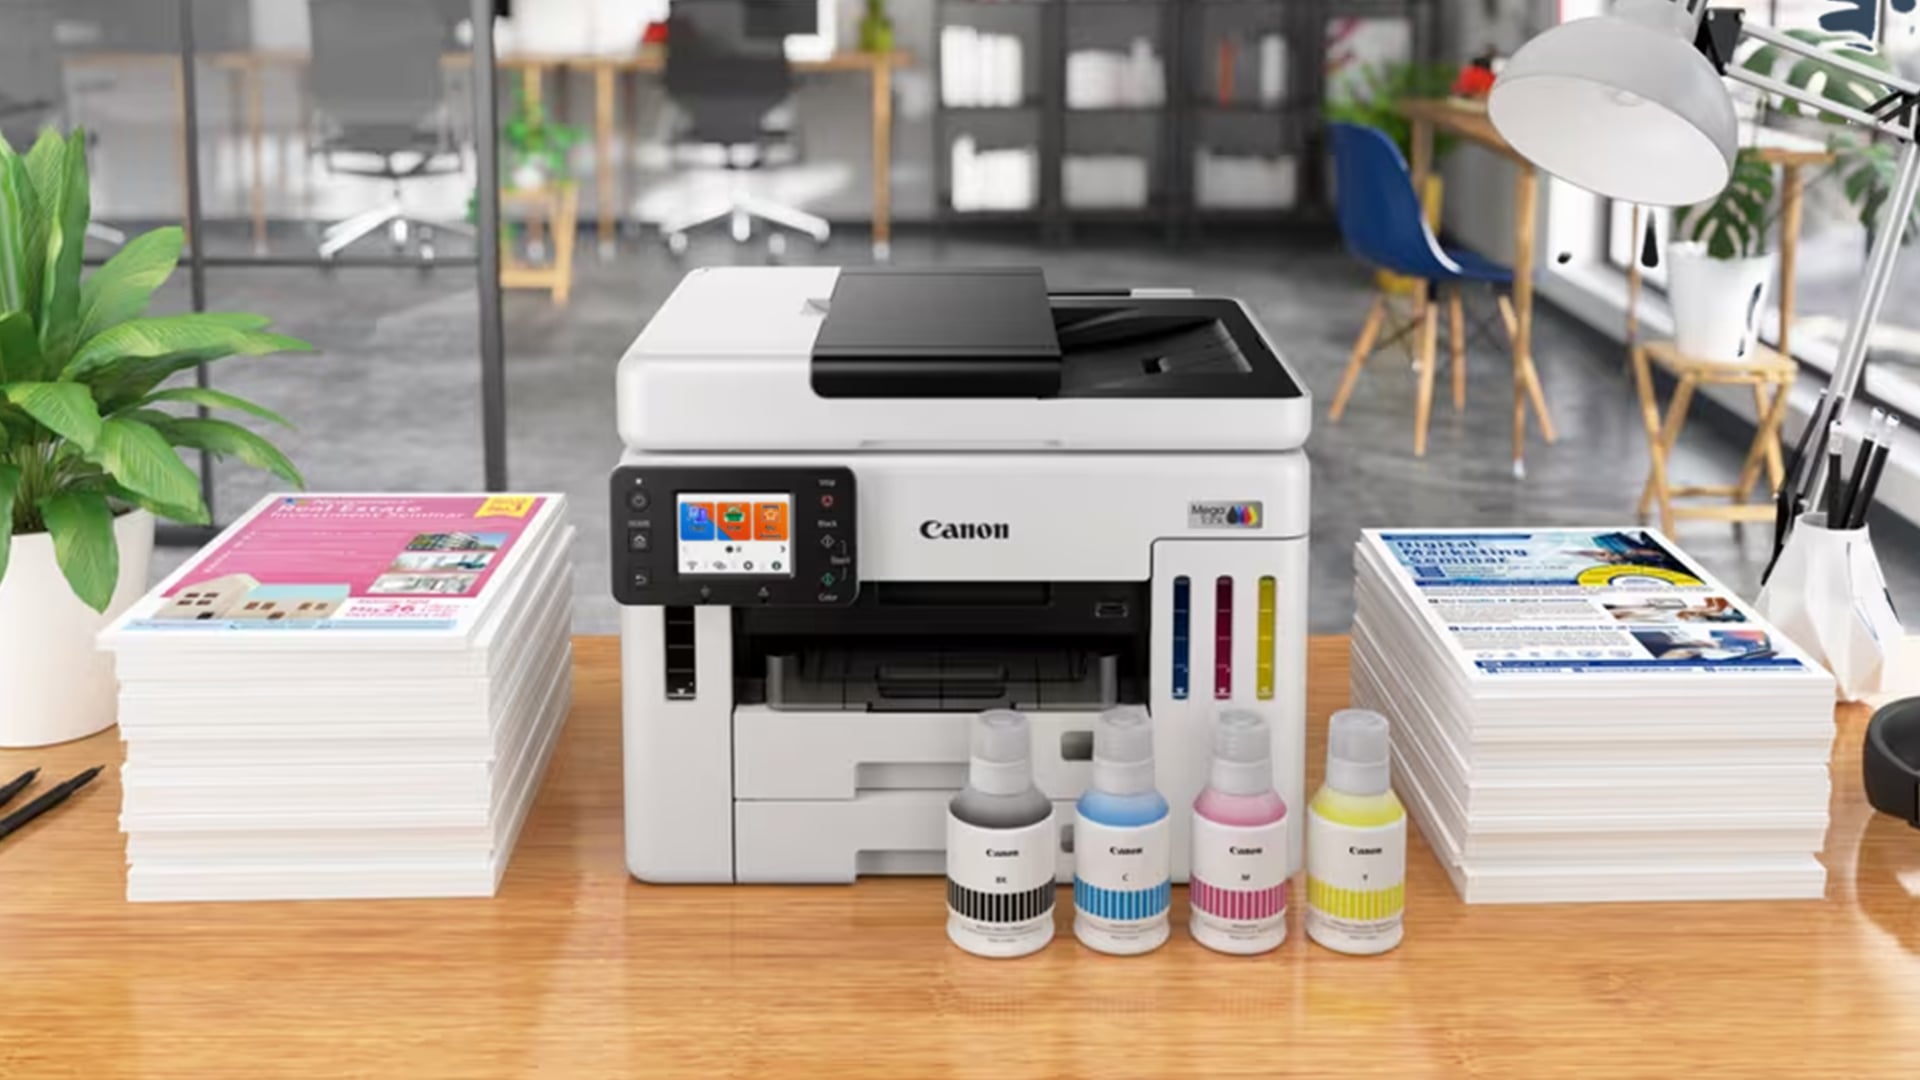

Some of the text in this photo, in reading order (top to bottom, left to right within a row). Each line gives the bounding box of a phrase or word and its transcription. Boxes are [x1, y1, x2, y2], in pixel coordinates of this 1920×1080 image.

[340, 504, 423, 512] Estate
[919, 520, 1010, 540] Canon
[1397, 539, 1478, 549] Digital
[1402, 547, 1529, 557] Marketing
[1408, 556, 1506, 564] Seminar
[986, 849, 1019, 858] Canon
[1109, 846, 1143, 856] Canon
[1229, 846, 1263, 856] Canon
[1348, 846, 1383, 856] Canon
[1122, 873, 1129, 882] C
